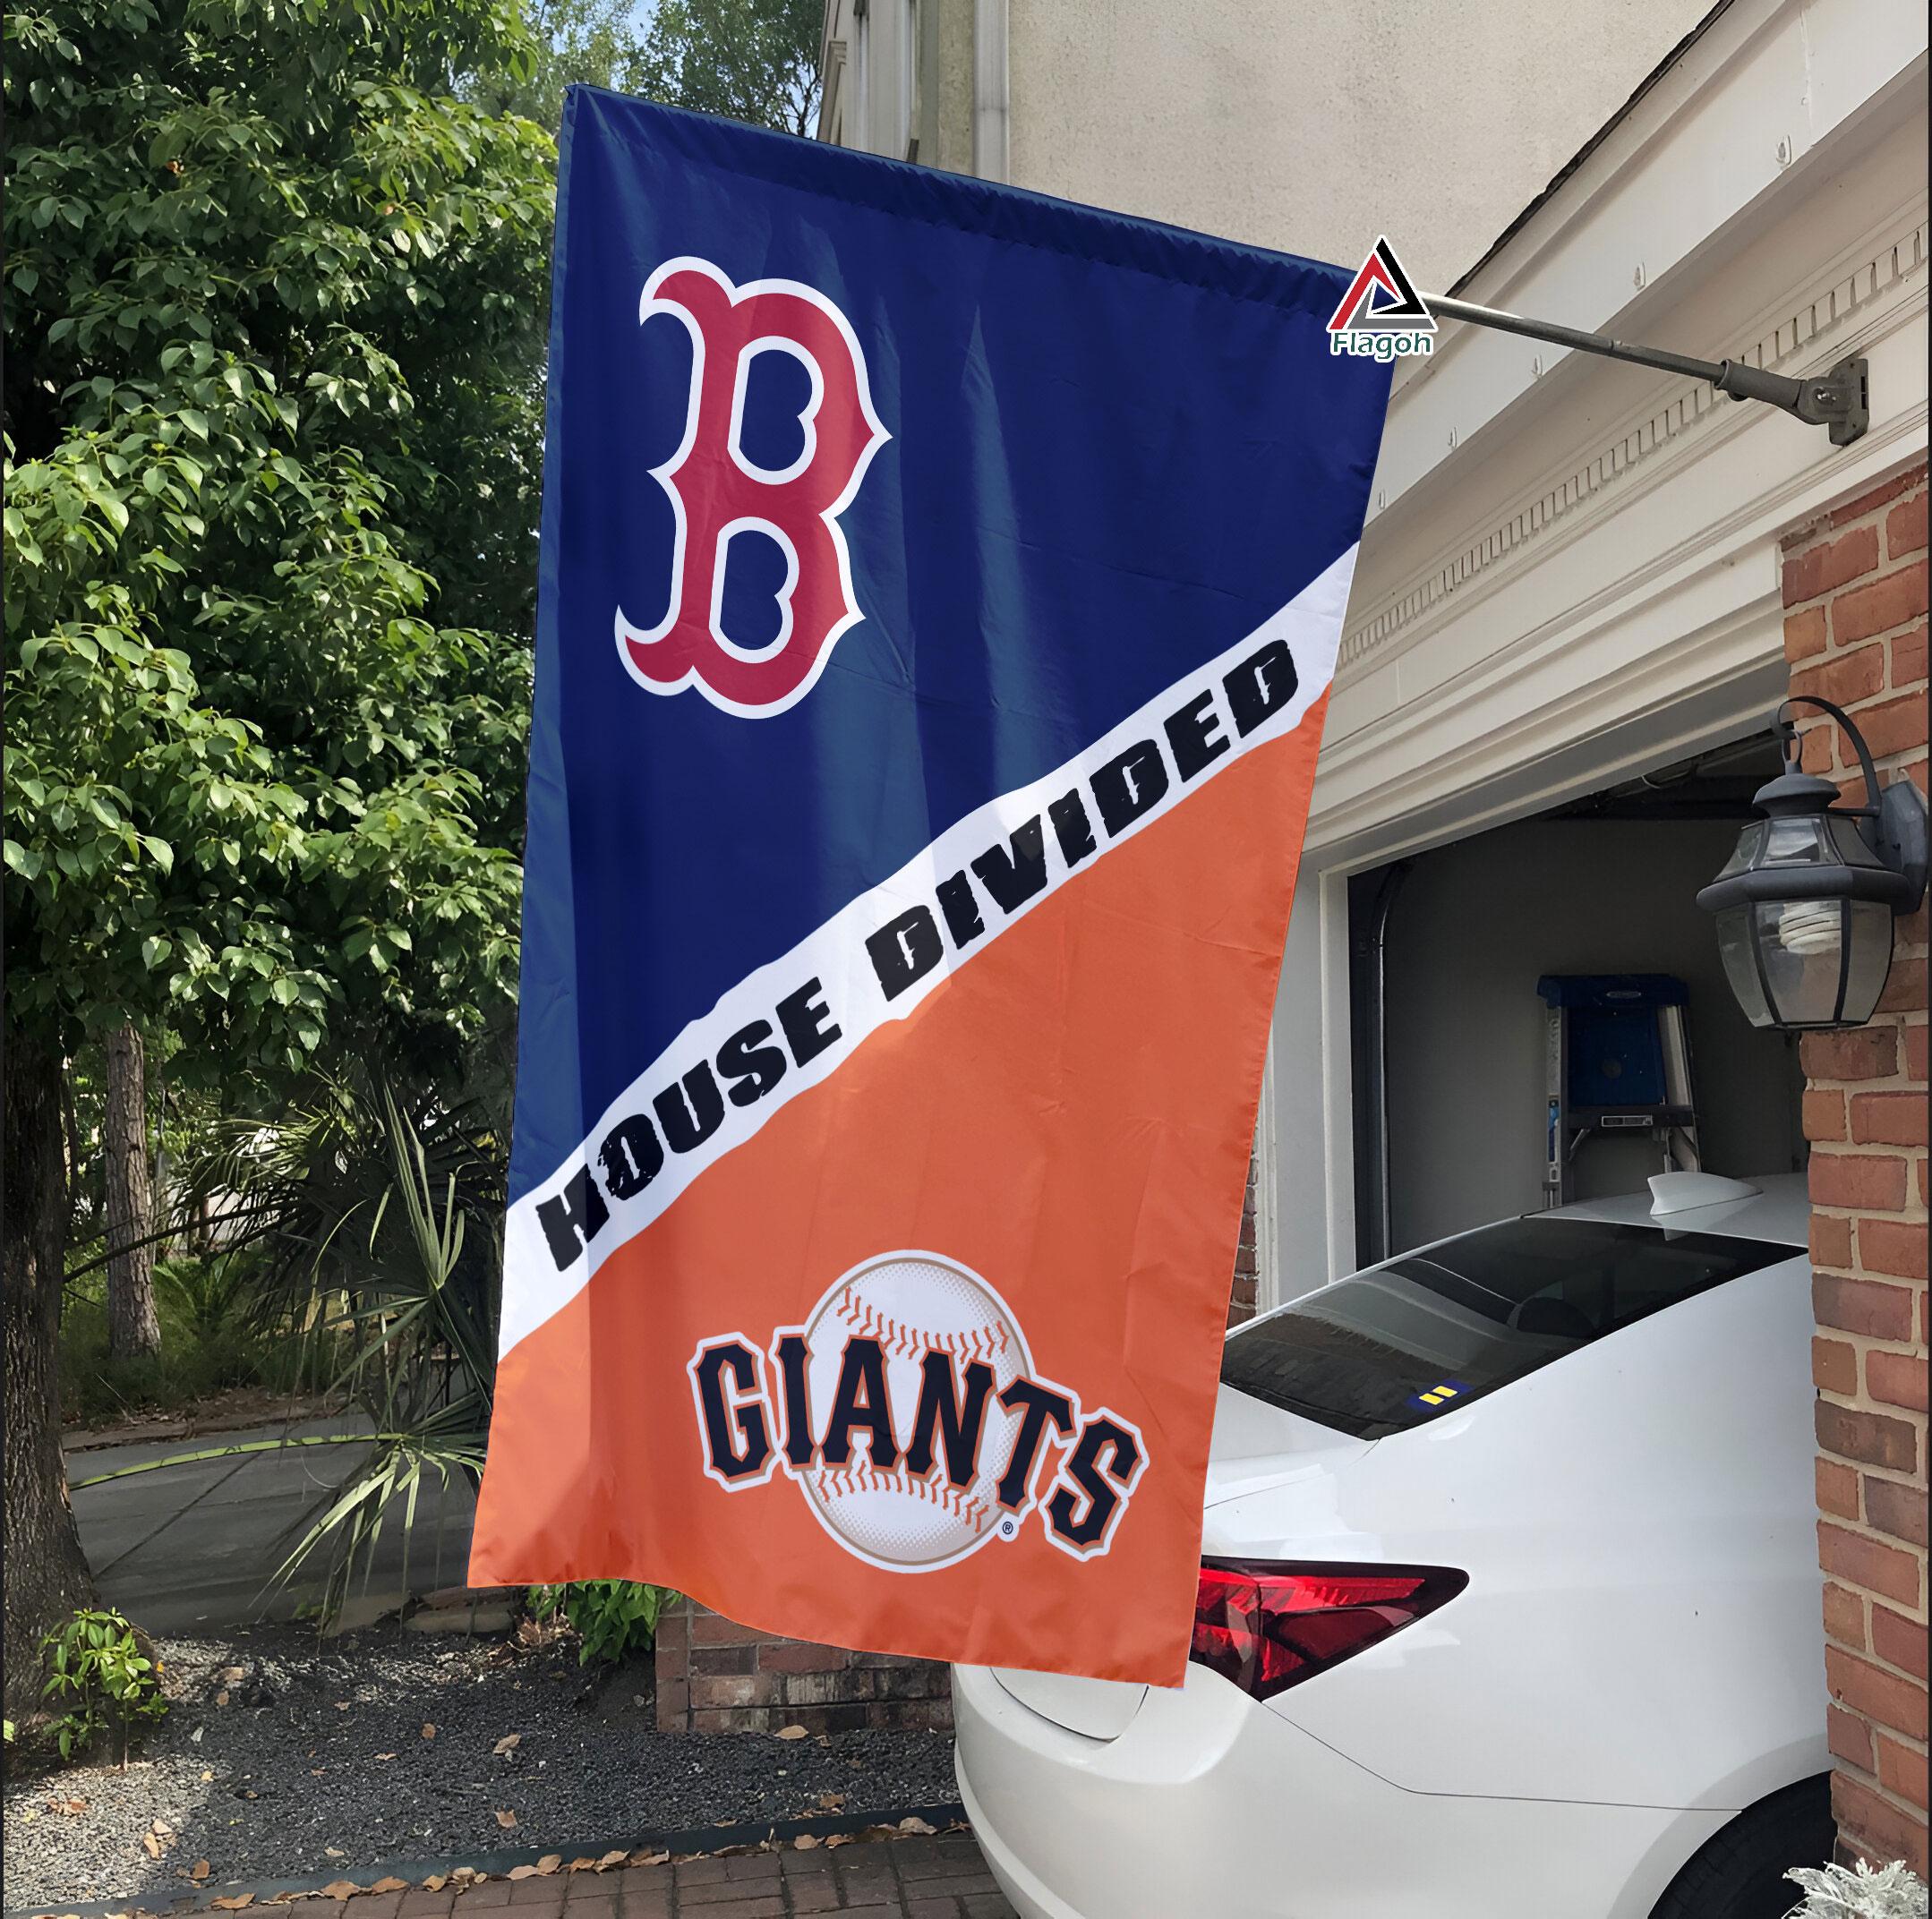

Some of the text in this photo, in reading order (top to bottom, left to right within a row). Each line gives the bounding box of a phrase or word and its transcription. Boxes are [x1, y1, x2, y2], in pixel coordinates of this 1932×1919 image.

[535, 638, 1300, 1272] HOUSE DIVIDED
[691, 1330, 1144, 1551] GIANTS
